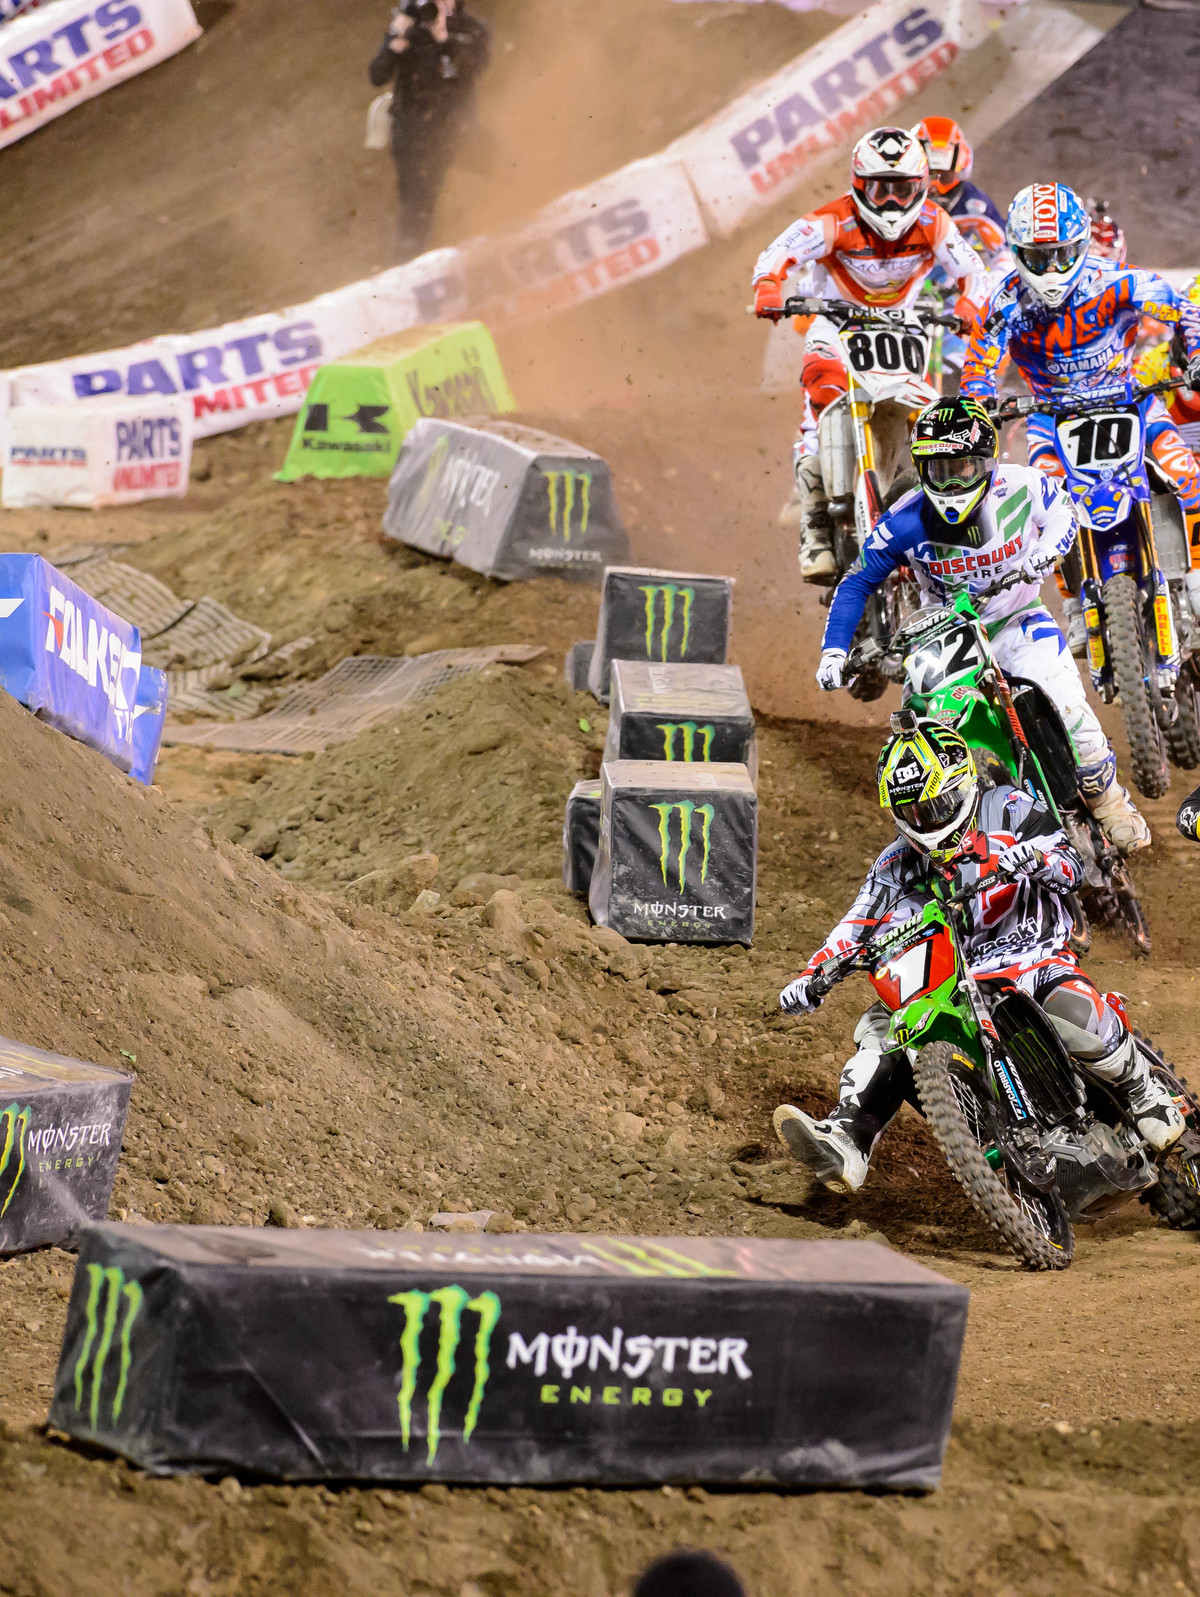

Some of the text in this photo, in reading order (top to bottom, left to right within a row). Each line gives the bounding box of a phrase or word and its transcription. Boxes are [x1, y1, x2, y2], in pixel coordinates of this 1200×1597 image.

[730, 8, 943, 170] PARTS
[412, 198, 650, 320] PRTS
[72, 321, 321, 398] PARTS
[847, 333, 925, 374] 800
[1060, 345, 1114, 373] YAMAHA
[115, 417, 181, 462] PARTS
[1068, 417, 1133, 466] 10
[529, 548, 602, 562] MONSTER
[929, 535, 1024, 574] DISCOUNT
[960, 565, 1004, 581] TIRE
[890, 782, 924, 794] MONSTER
[633, 900, 727, 919] MONSTER
[647, 919, 713, 929] ENERGY
[973, 916, 1040, 957] wasaki
[993, 1060, 1017, 1101] CARRILLO
[28, 1122, 111, 1156] MONSTER
[39, 1155, 94, 1173] ENERGY
[506, 1325, 752, 1380] MONSTER
[540, 1384, 713, 1407] ENERGY
